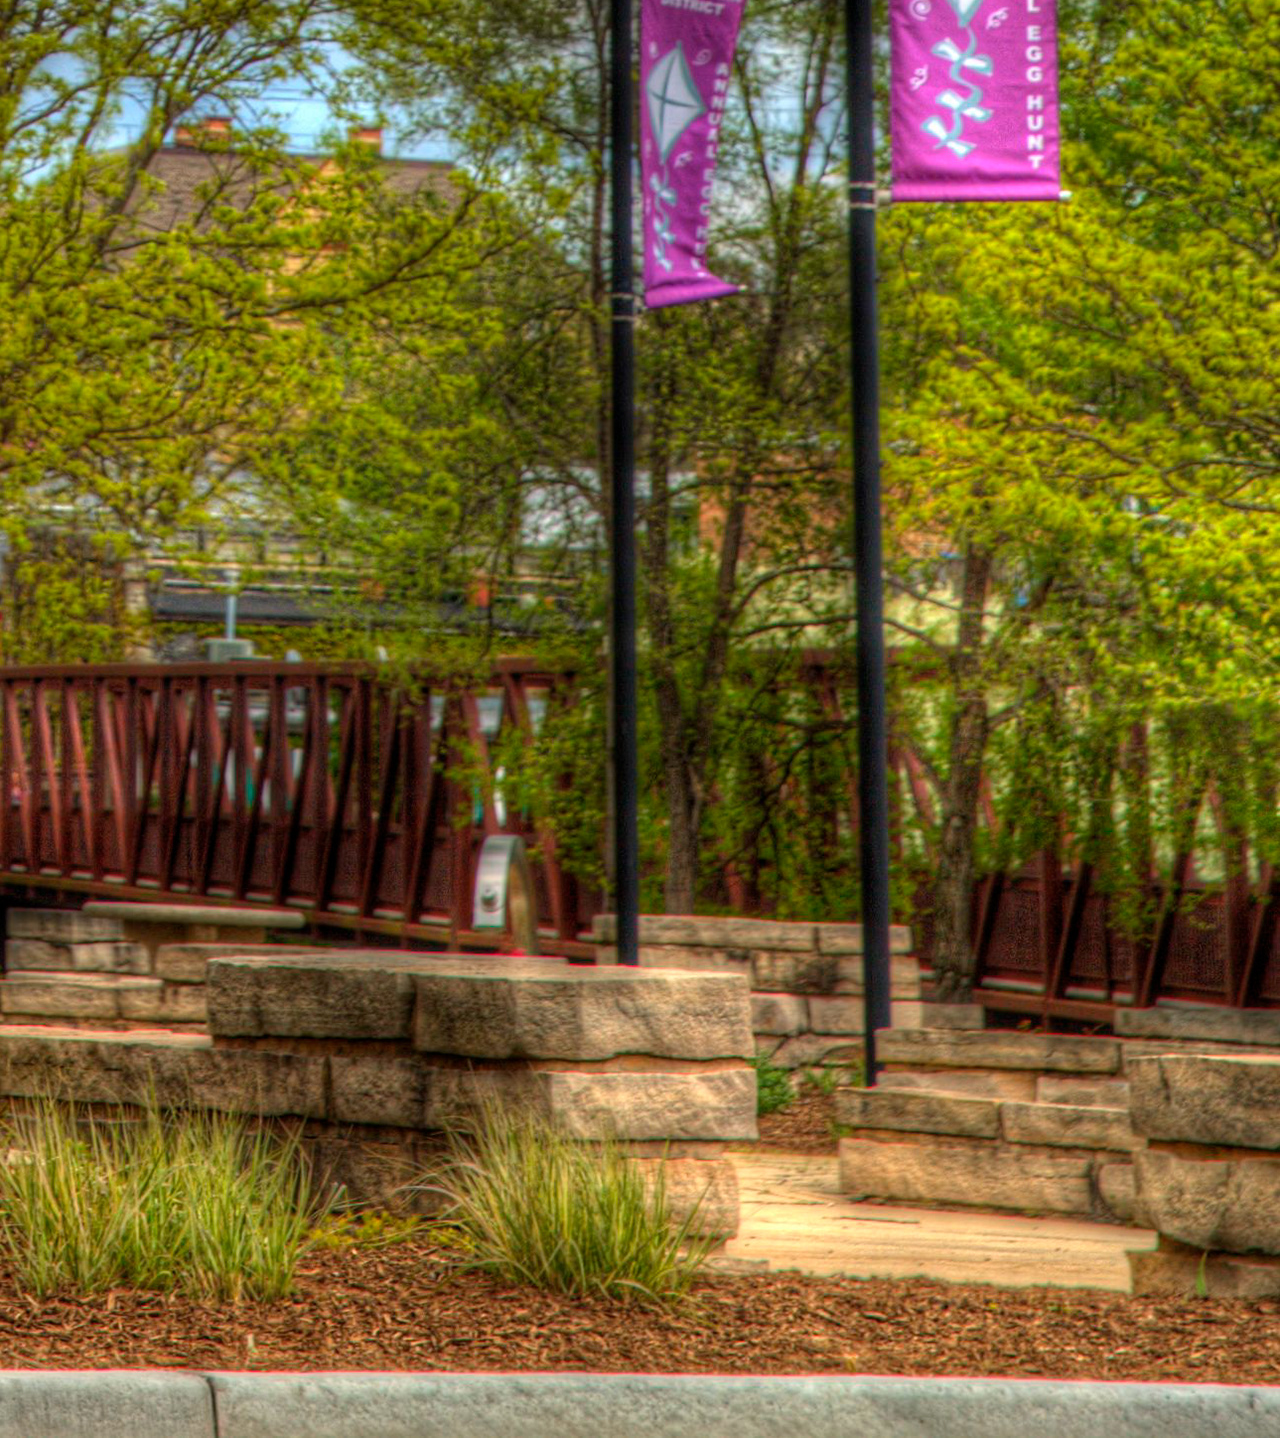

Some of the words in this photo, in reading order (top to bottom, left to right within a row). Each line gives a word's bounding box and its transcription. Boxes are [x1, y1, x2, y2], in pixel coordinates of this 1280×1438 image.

[1025, 25, 1042, 82] EGG
[705, 62, 729, 159] ANNUAL
[1026, 94, 1044, 169] HUNT
